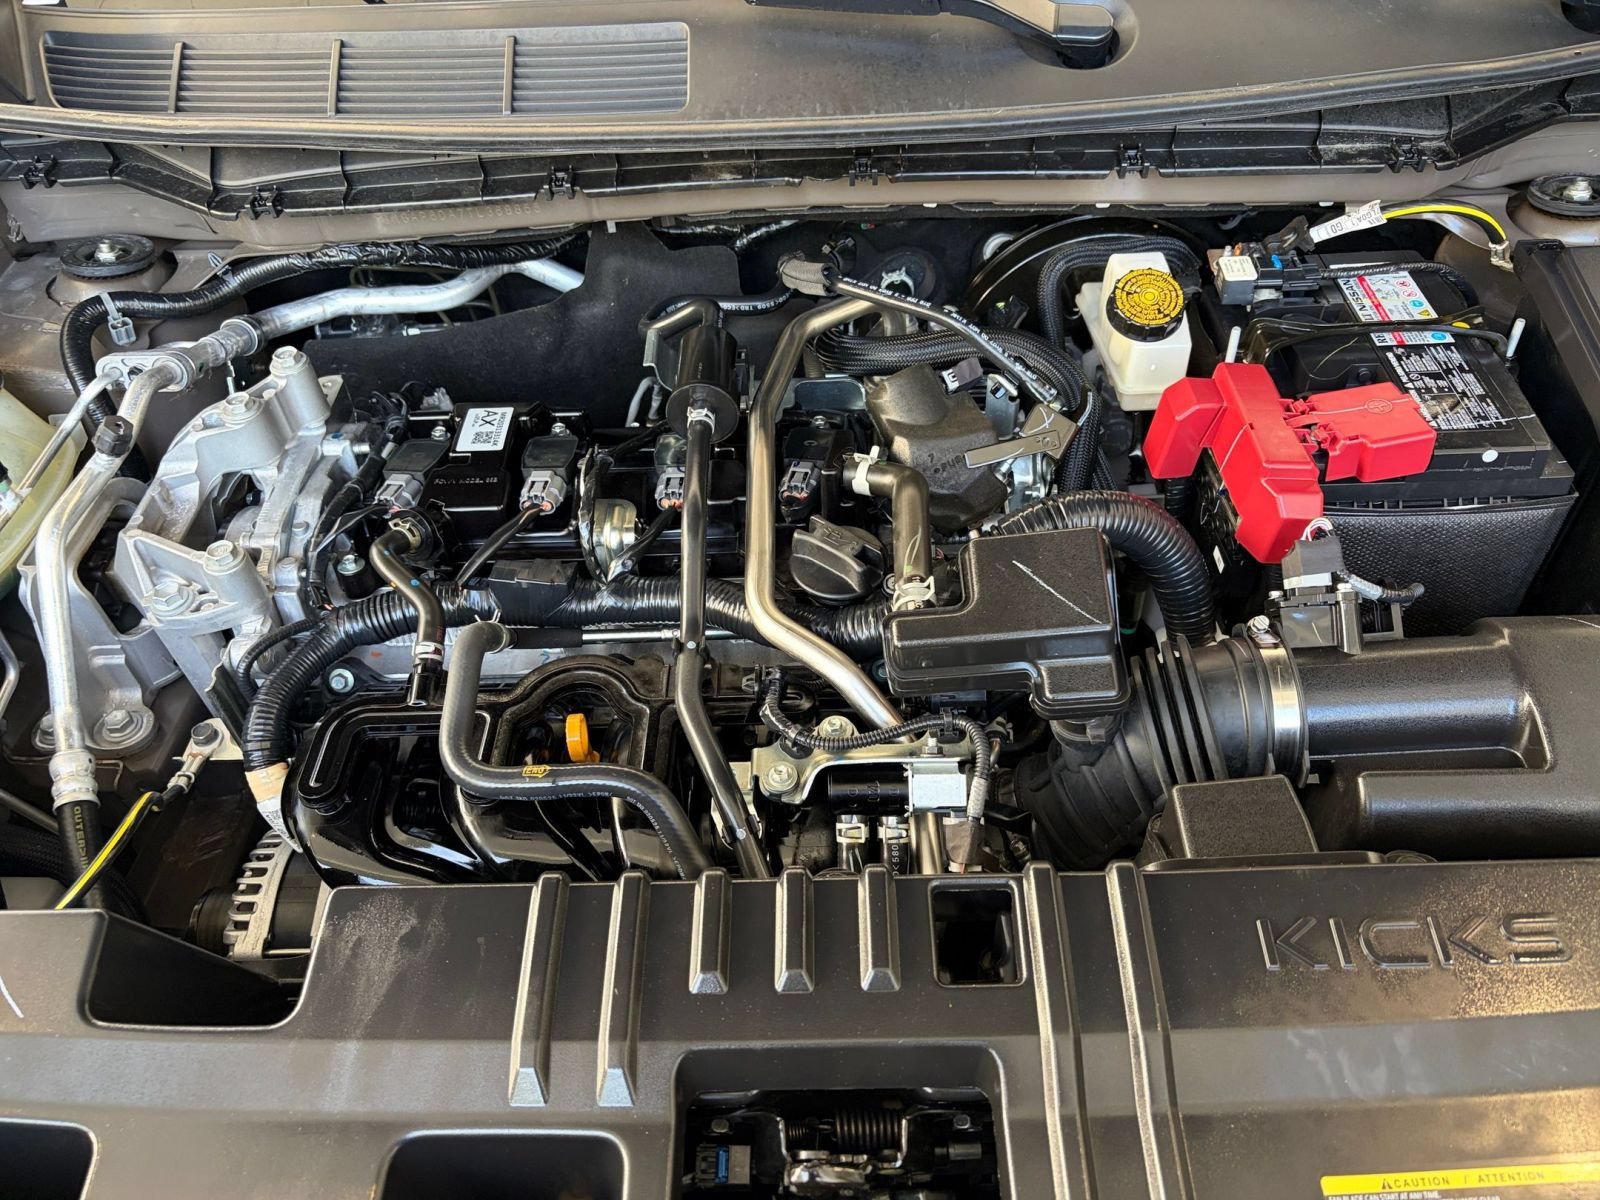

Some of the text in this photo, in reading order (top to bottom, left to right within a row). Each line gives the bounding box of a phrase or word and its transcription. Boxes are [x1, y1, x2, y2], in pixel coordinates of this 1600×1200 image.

[1341, 279, 1368, 312] NISSAN
[478, 409, 499, 428] AX
[1256, 914, 1572, 971] KICKS
[1393, 1176, 1451, 1189] CAUTION
[1477, 1171, 1545, 1184] ATTENTION
